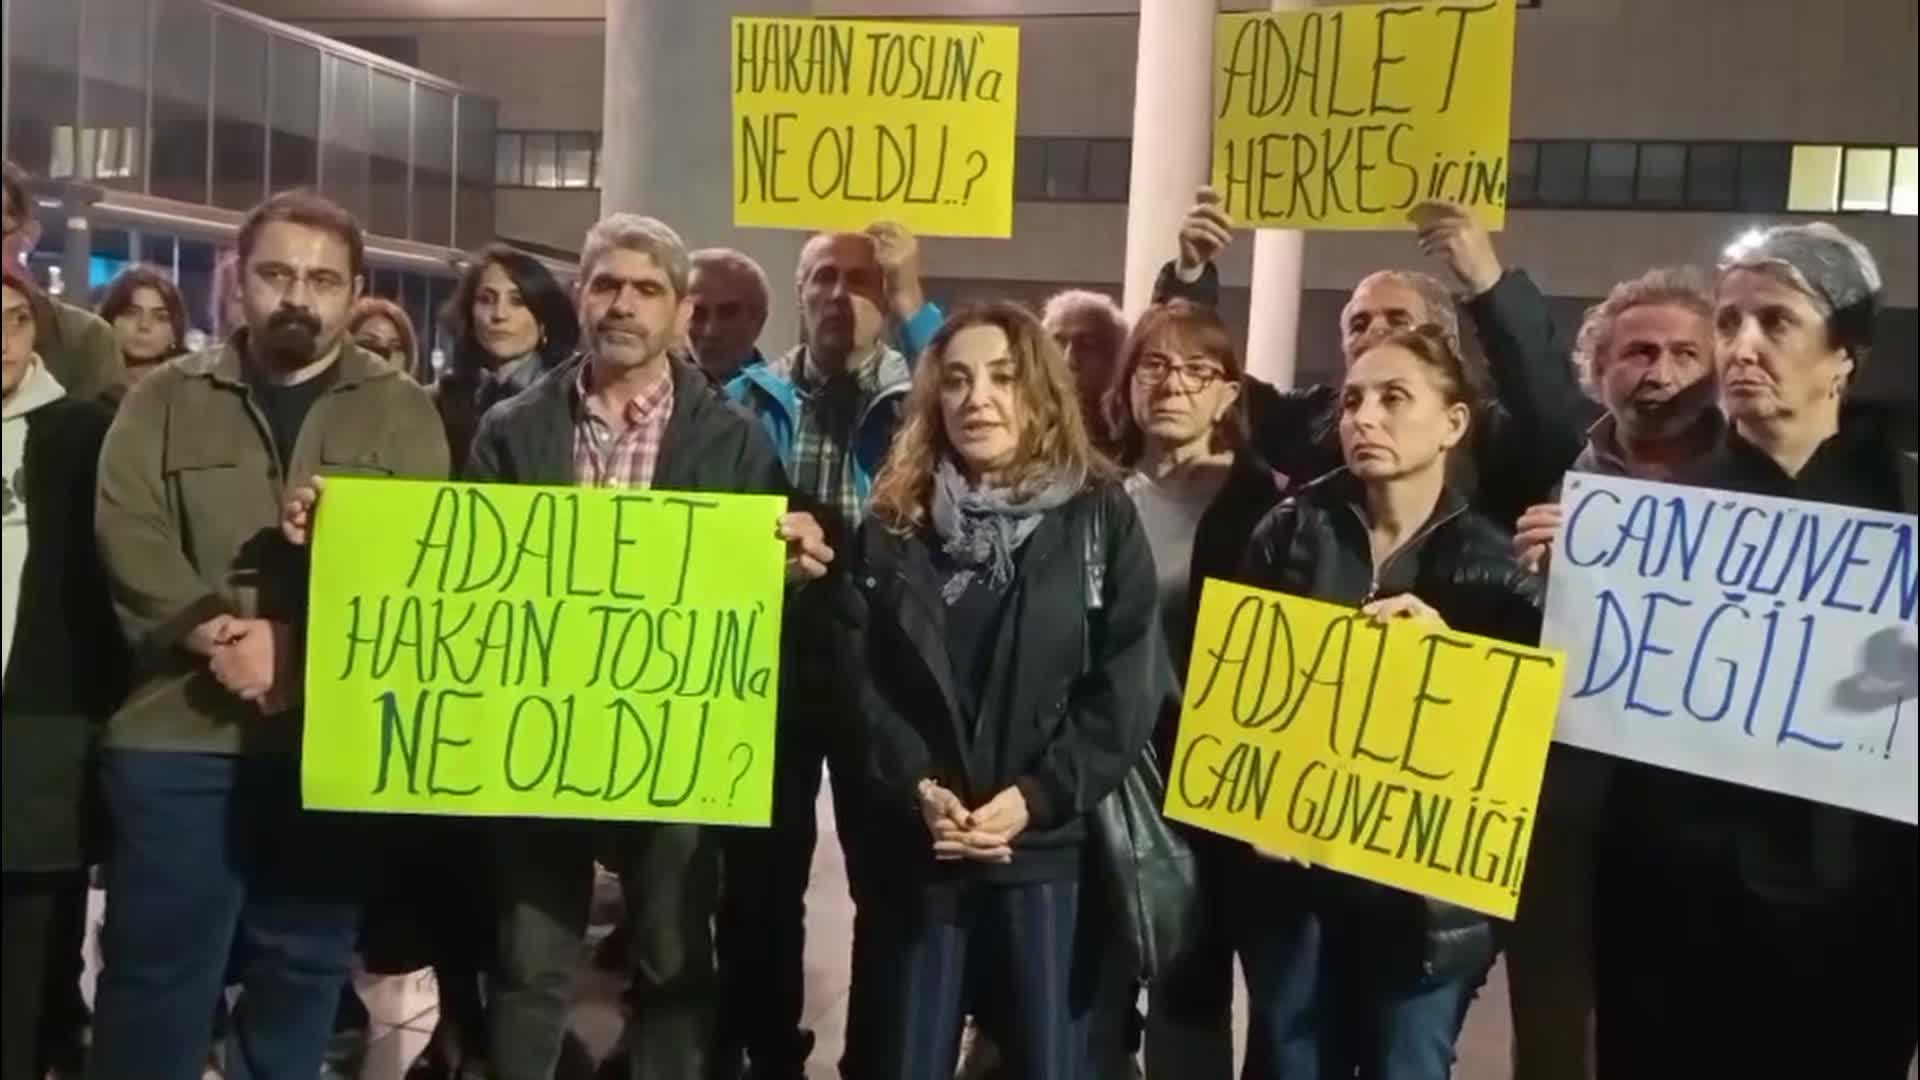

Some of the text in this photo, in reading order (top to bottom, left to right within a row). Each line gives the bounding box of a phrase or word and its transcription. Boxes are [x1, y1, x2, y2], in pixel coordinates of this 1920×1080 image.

[736, 23, 853, 94] HAKAN
[1219, 2, 1496, 118] ADALET
[740, 113, 799, 203] NE
[1225, 123, 1418, 221] HERKES
[406, 487, 719, 605] ADALET
[339, 595, 566, 687] HAKAN
[373, 690, 483, 795] NE
[1194, 596, 1554, 792] ADALET
[1179, 734, 1281, 820] CAN
